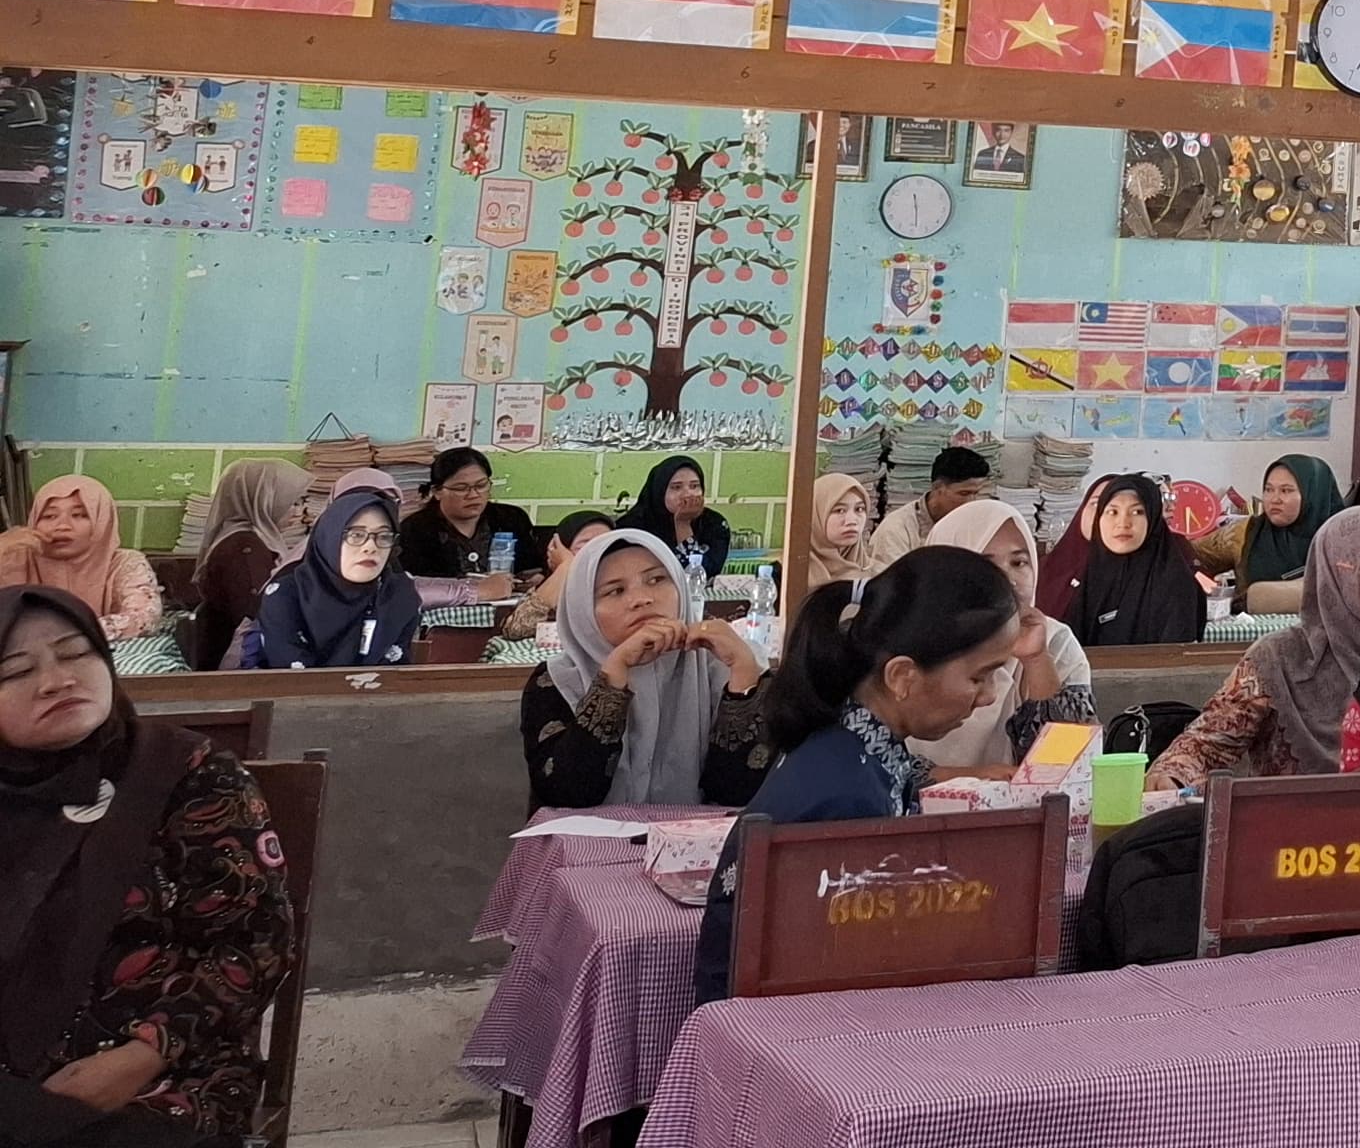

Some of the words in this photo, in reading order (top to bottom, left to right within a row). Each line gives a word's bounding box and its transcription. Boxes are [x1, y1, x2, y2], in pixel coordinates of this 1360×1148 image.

[1330, 5, 1346, 17] 10
[1323, 27, 1332, 38] 9
[546, 51, 558, 65] 5
[1329, 53, 1338, 64] 8
[740, 66, 751, 80] 6
[1348, 70, 1355, 81] 7
[901, 122, 941, 131] PANCASILA
[673, 221, 690, 272] PROVINSI
[664, 292, 681, 346] INDONESIA
[1276, 844, 1337, 879] BOS
[827, 886, 896, 925] BOS
